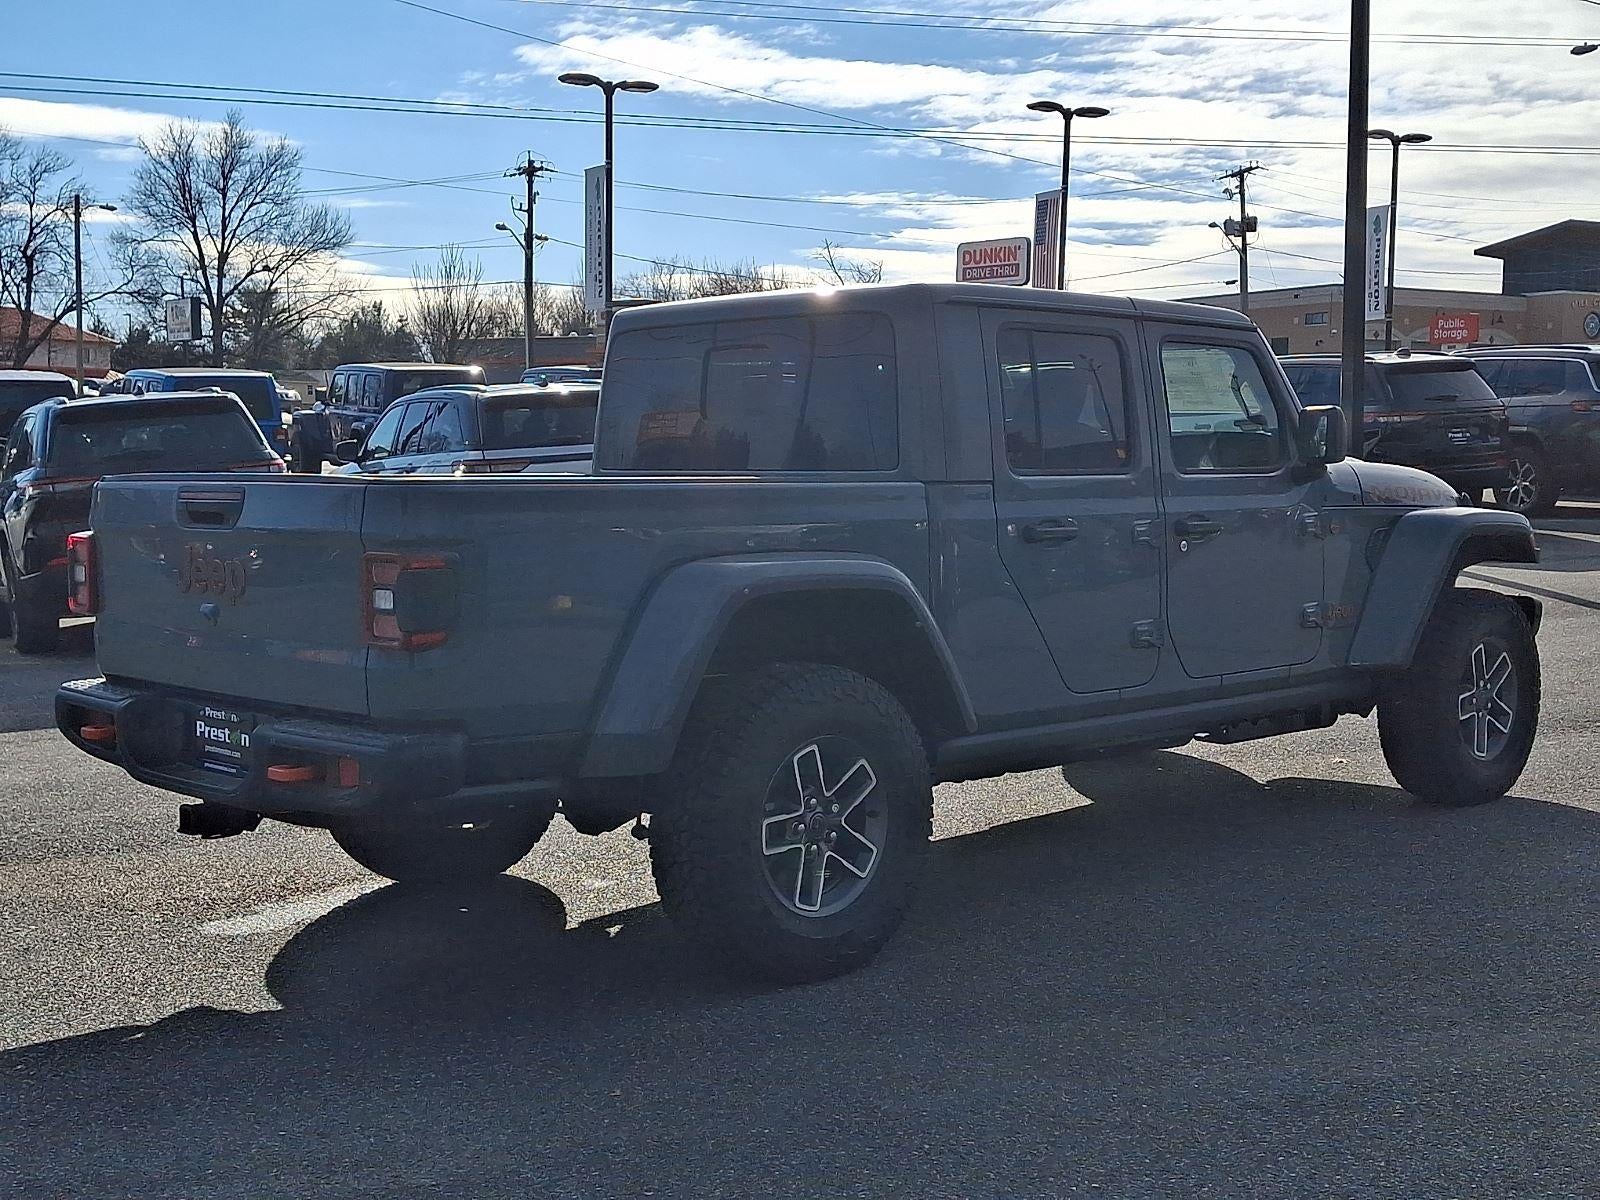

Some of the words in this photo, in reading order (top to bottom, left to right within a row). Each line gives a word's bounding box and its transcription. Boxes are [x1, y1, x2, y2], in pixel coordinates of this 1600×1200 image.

[962, 244, 1021, 266] DUNKIN'
[966, 267, 991, 279] DRIVE
[992, 265, 1016, 277] THRU
[1372, 237, 1382, 312] PRESTON
[1433, 329, 1469, 340] Storage
[1438, 318, 1466, 329] Public
[177, 544, 247, 607] Jeep
[196, 720, 250, 748] Preston
